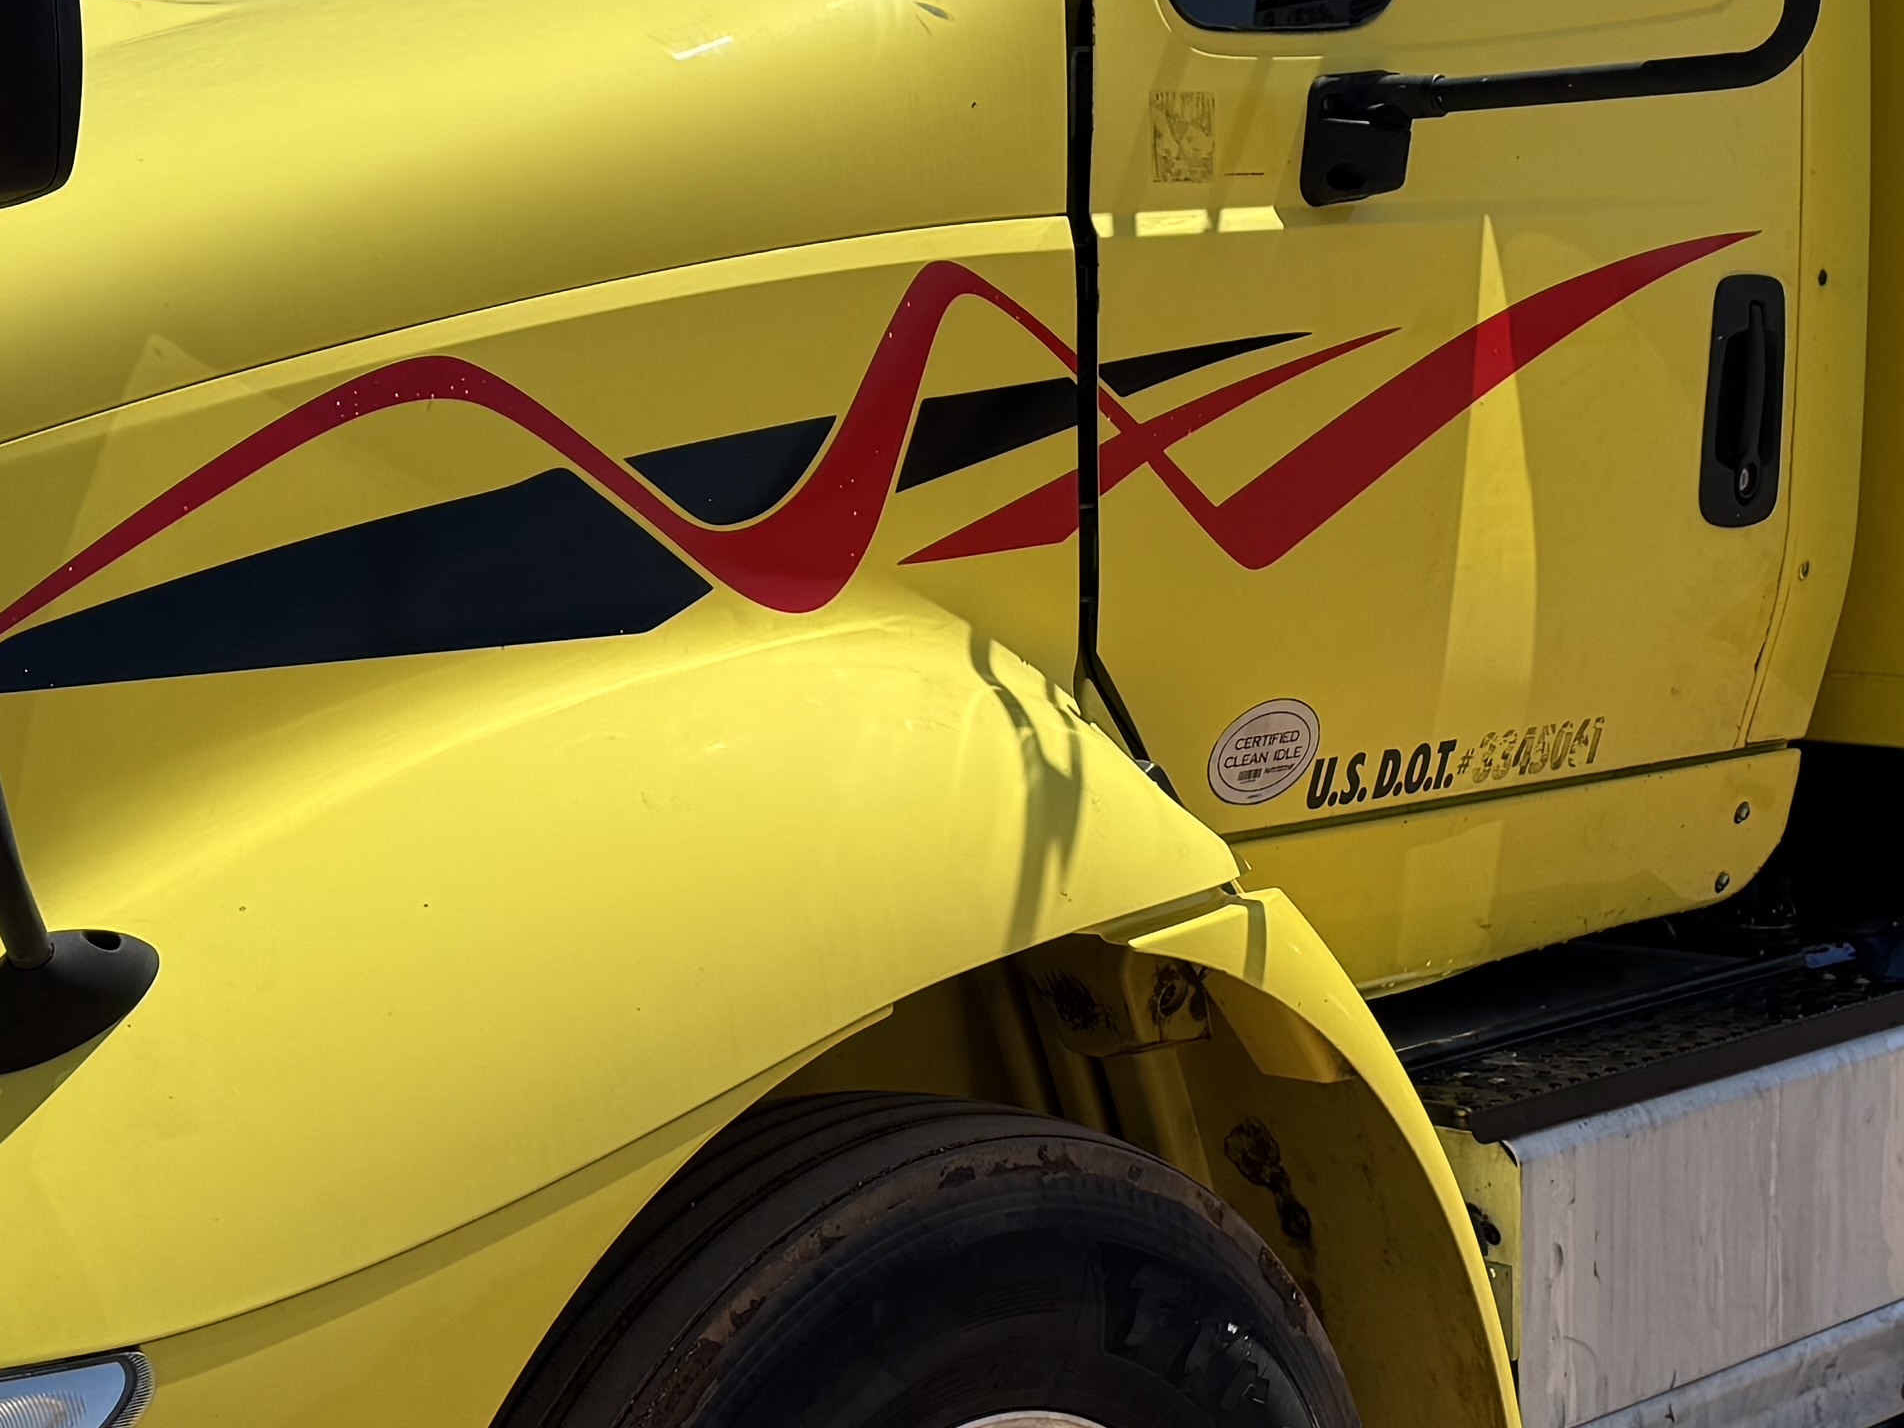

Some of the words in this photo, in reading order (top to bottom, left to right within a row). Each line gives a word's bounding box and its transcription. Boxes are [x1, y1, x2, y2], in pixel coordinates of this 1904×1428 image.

[1234, 729, 1301, 751] CERTIFIED
[1223, 751, 1270, 770] CLEAN
[1272, 745, 1303, 762] IDLE
